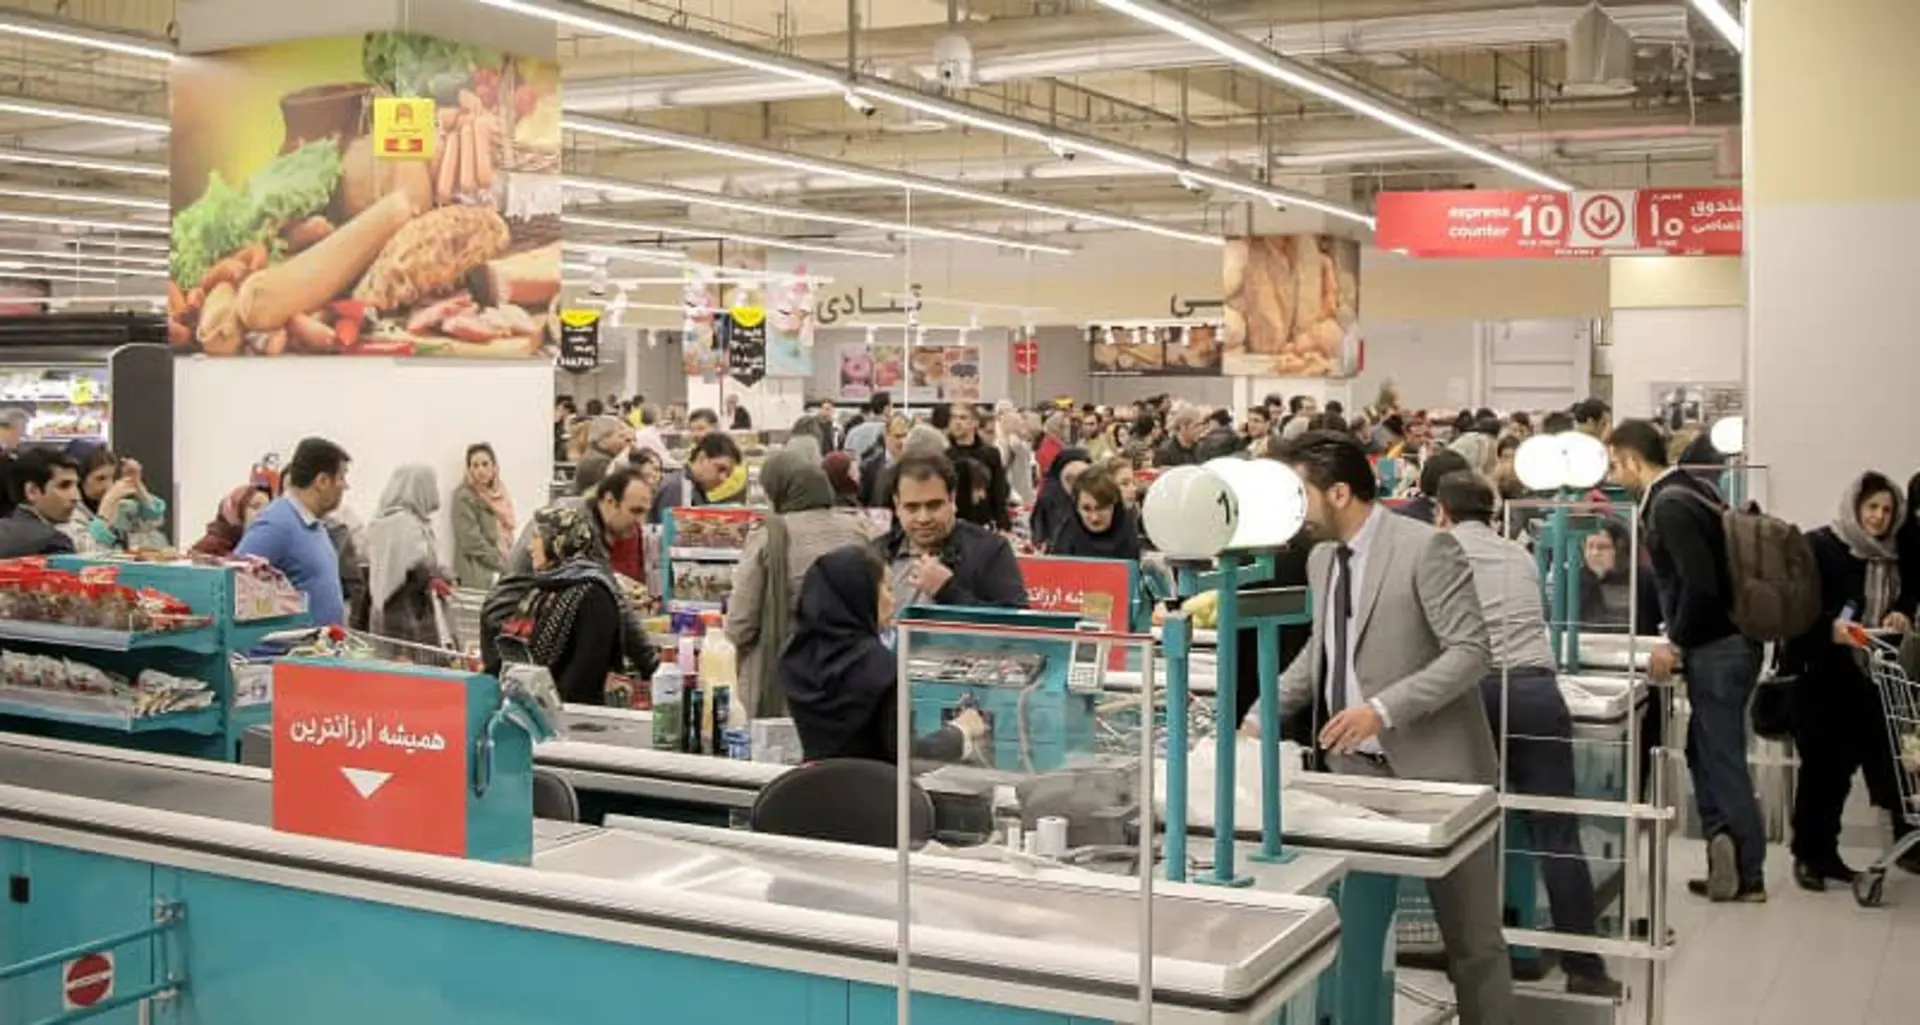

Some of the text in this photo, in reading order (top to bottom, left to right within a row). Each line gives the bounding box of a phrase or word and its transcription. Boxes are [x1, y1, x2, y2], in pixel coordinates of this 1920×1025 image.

[1447, 207, 1511, 221] express
[1514, 204, 1562, 237] 10
[1448, 225, 1510, 239] counter
[290, 712, 446, 754] همیشه ارزانترین
